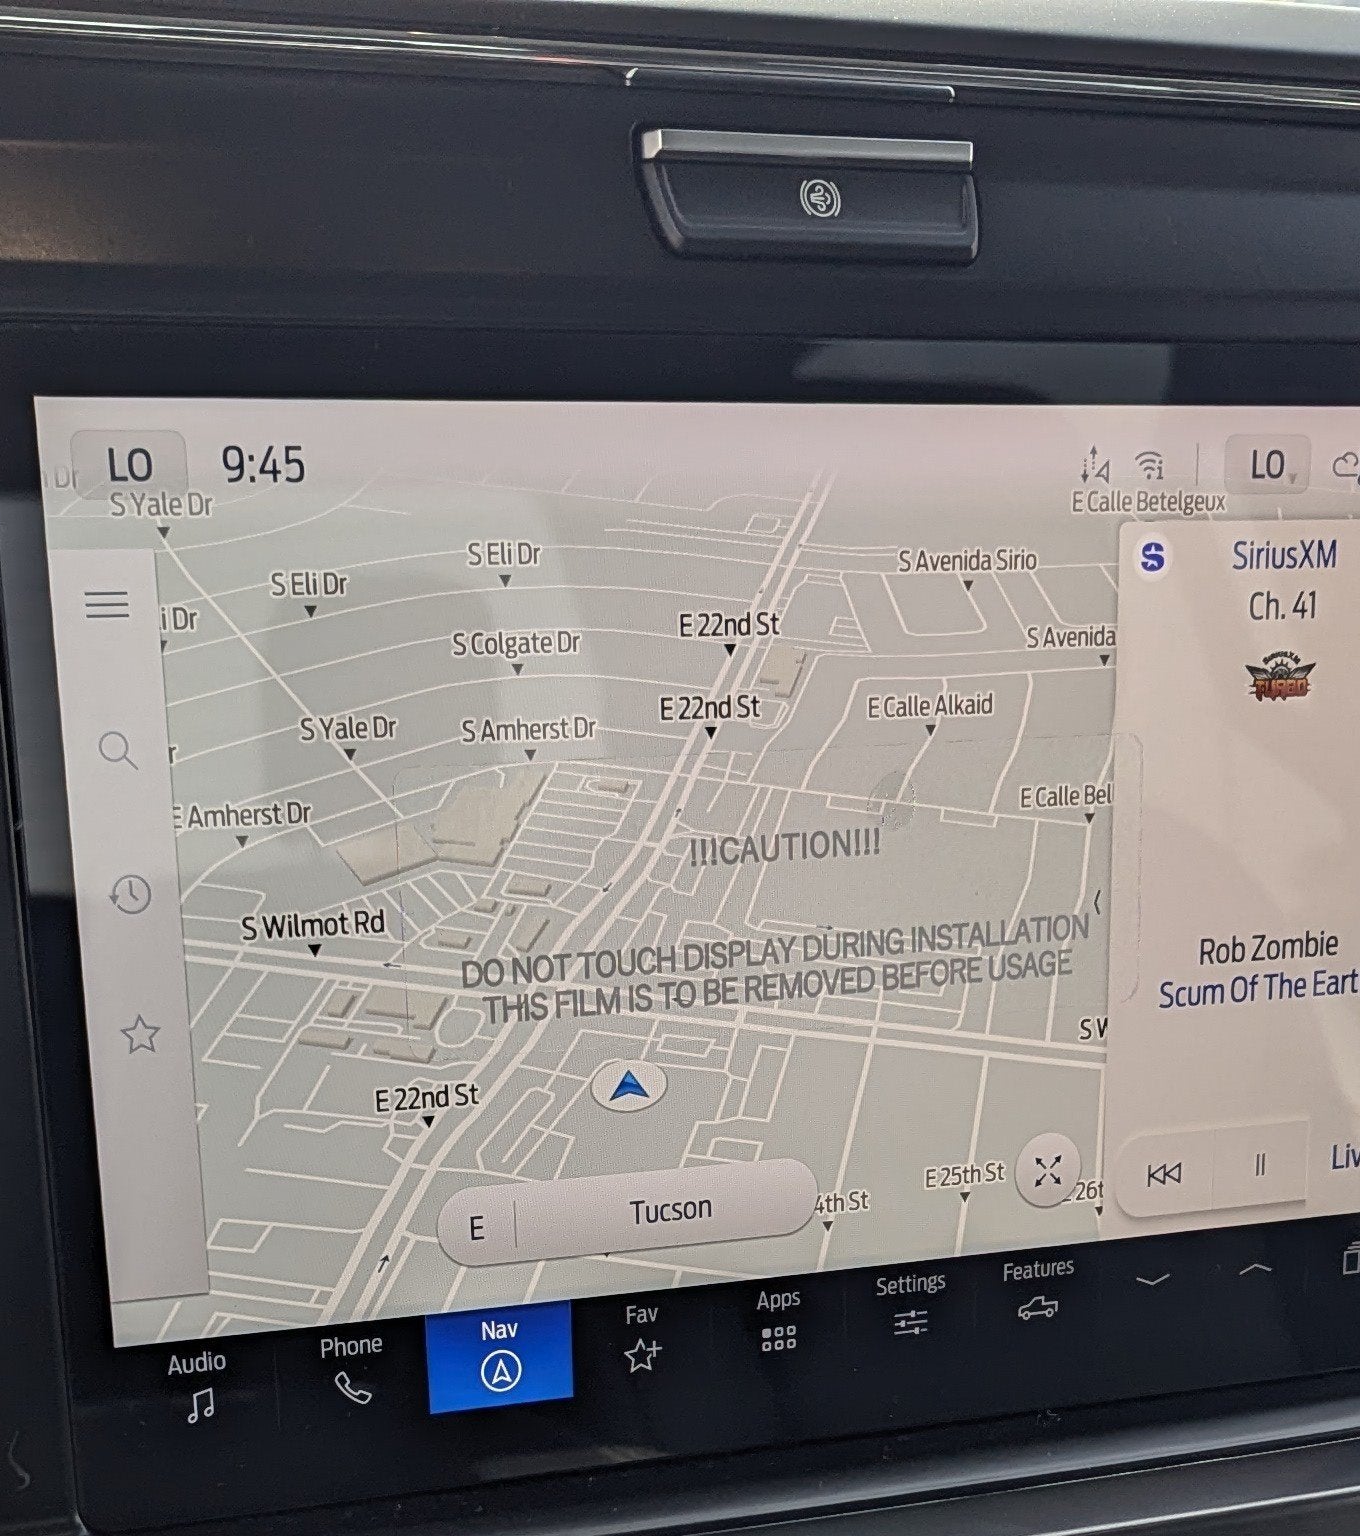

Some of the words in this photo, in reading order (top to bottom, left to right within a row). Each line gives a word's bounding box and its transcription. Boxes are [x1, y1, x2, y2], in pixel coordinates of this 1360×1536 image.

[107, 447, 153, 483] LO
[222, 444, 306, 484] 9:45
[1250, 448, 1286, 480] LO
[110, 492, 127, 517] S
[130, 491, 183, 517] Yale
[188, 492, 214, 516] Dr
[1072, 492, 1084, 514] E
[1087, 491, 1133, 513] Calle
[1136, 490, 1227, 516] Betelgeux
[468, 542, 482, 566] S
[487, 542, 513, 566] Eli
[518, 542, 542, 565] Dr
[899, 550, 912, 573] S
[915, 548, 993, 573] Avenida
[995, 547, 1038, 572] Sirio
[1232, 539, 1338, 571] SiriusXM
[271, 572, 286, 597] S
[291, 571, 318, 596] Eli
[323, 571, 348, 595] Dr
[172, 607, 198, 631] Dr
[1249, 590, 1287, 621] Ch.
[1291, 590, 1318, 620] 41
[679, 614, 693, 638] E
[697, 611, 753, 638] 22nd
[755, 611, 780, 637] St
[1027, 627, 1039, 649] S
[1042, 625, 1117, 648] Avenida
[452, 632, 467, 657] S
[470, 630, 554, 660] Colgate
[557, 630, 581, 653] Dr
[660, 697, 674, 722] E
[678, 694, 733, 721] 22nd
[736, 694, 761, 719] St
[868, 697, 881, 719] E
[883, 695, 932, 719] Calle
[934, 693, 994, 717] Alkaid
[300, 718, 316, 742] S
[318, 716, 369, 741] Yale
[373, 715, 398, 739] Dr
[462, 719, 476, 743] S
[480, 717, 570, 742] Amherst
[574, 716, 597, 740] Dr
[1020, 787, 1032, 808] E
[1035, 786, 1080, 808] Calle
[187, 803, 284, 829] Amherst
[287, 802, 312, 826] Dr
[690, 828, 881, 867] !!!CAUTION!!!
[241, 916, 256, 942] S
[260, 912, 349, 939] Wilmot
[354, 908, 386, 935] Rd
[461, 958, 505, 989] DO
[512, 954, 572, 985] NOT
[577, 945, 676, 979] TOUCH
[684, 935, 797, 972] DISPLAY
[802, 927, 905, 963] DURING
[912, 912, 1090, 952] INSTALLATION
[1198, 936, 1246, 967] Rob
[1251, 929, 1340, 963] Zombie
[482, 993, 548, 1025] THIS
[555, 985, 621, 1019] FILM
[628, 984, 653, 1012] IS
[658, 979, 697, 1009] TO
[703, 976, 739, 1007] BE
[744, 965, 876, 1003] REMOVED
[882, 955, 983, 991] BEFORE
[988, 948, 1074, 982] USAGE
[1158, 979, 1226, 1011] Scum
[1230, 973, 1260, 1004] Of
[1262, 971, 1307, 1002] The
[1078, 1018, 1093, 1041] S
[375, 1088, 389, 1113] E
[393, 1084, 451, 1111] 22nd
[453, 1082, 480, 1107] St
[925, 1168, 937, 1189] E
[940, 1164, 982, 1187] 25th
[986, 1162, 1006, 1183] St
[814, 1192, 846, 1215] 4th
[849, 1190, 870, 1211] St
[1075, 1181, 1105, 1202] 26t
[629, 1198, 713, 1226] Tucson
[469, 1215, 486, 1241] E
[1002, 1257, 1076, 1283] Features
[876, 1270, 948, 1299] Settings
[756, 1287, 802, 1313] Apps
[625, 1303, 660, 1327] Fav
[481, 1318, 520, 1342] Nav
[319, 1332, 384, 1360] Phone
[167, 1351, 228, 1377] Audio
